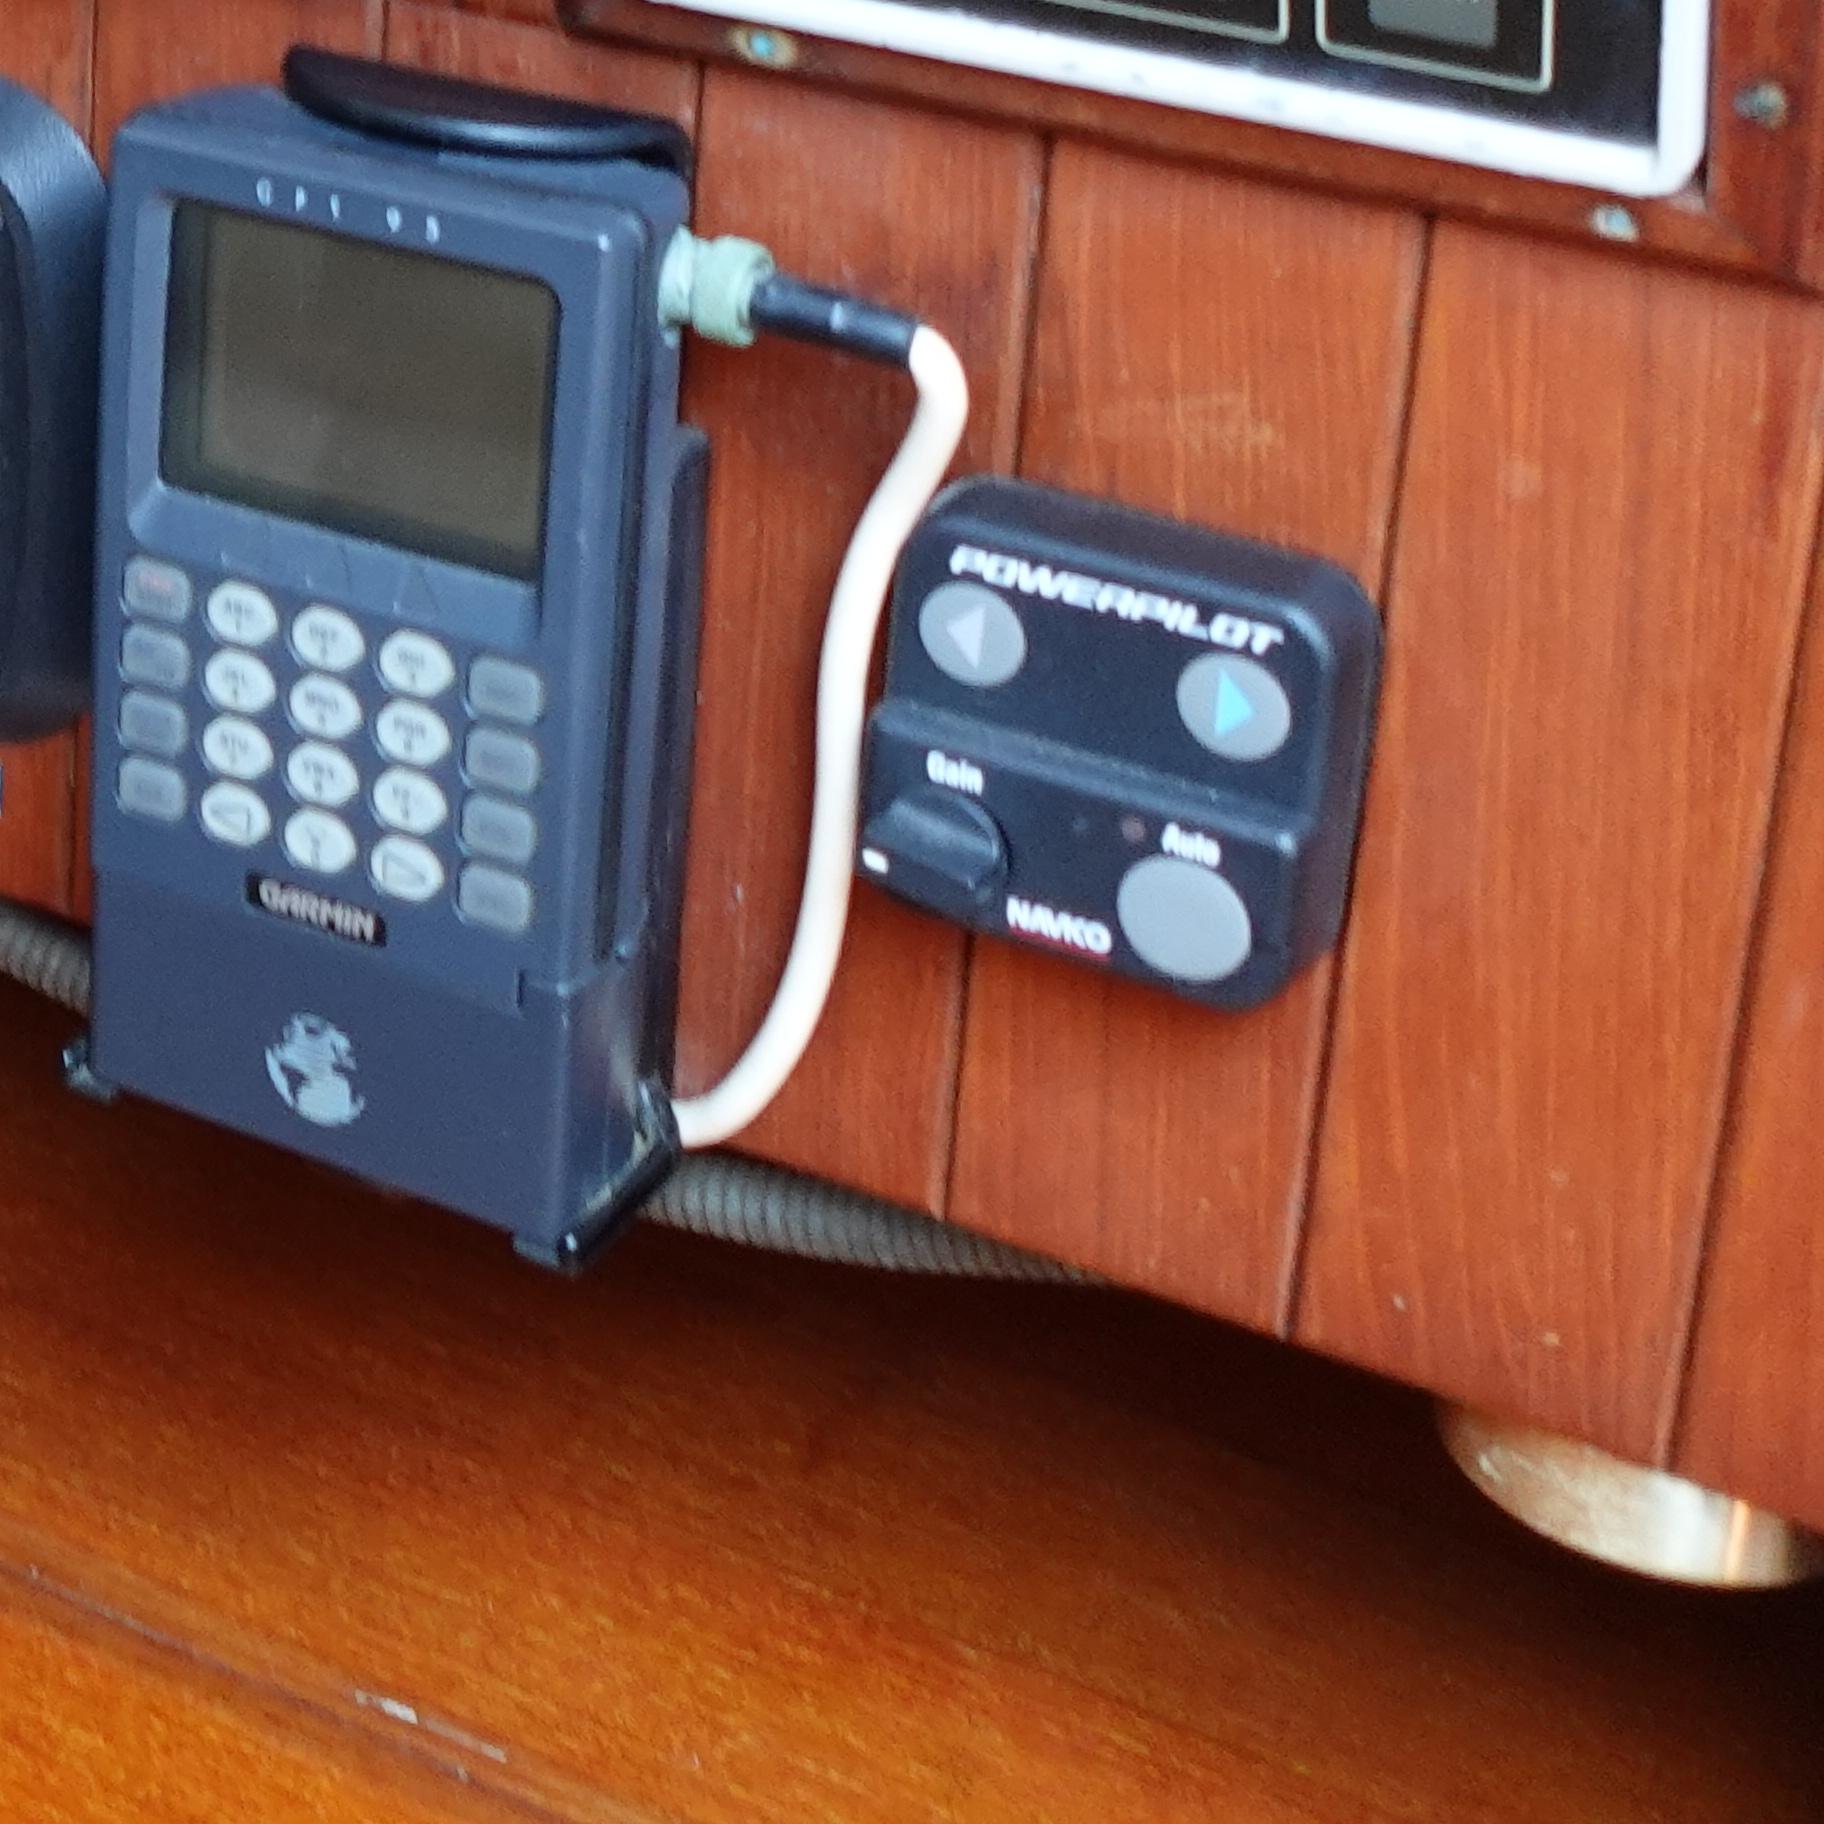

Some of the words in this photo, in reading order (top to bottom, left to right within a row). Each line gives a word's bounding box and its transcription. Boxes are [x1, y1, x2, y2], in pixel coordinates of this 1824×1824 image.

[949, 543, 1285, 656] POWERPILOT
[925, 748, 985, 798] Gain
[1160, 820, 1223, 869] Auto
[258, 878, 376, 944] GARMIN
